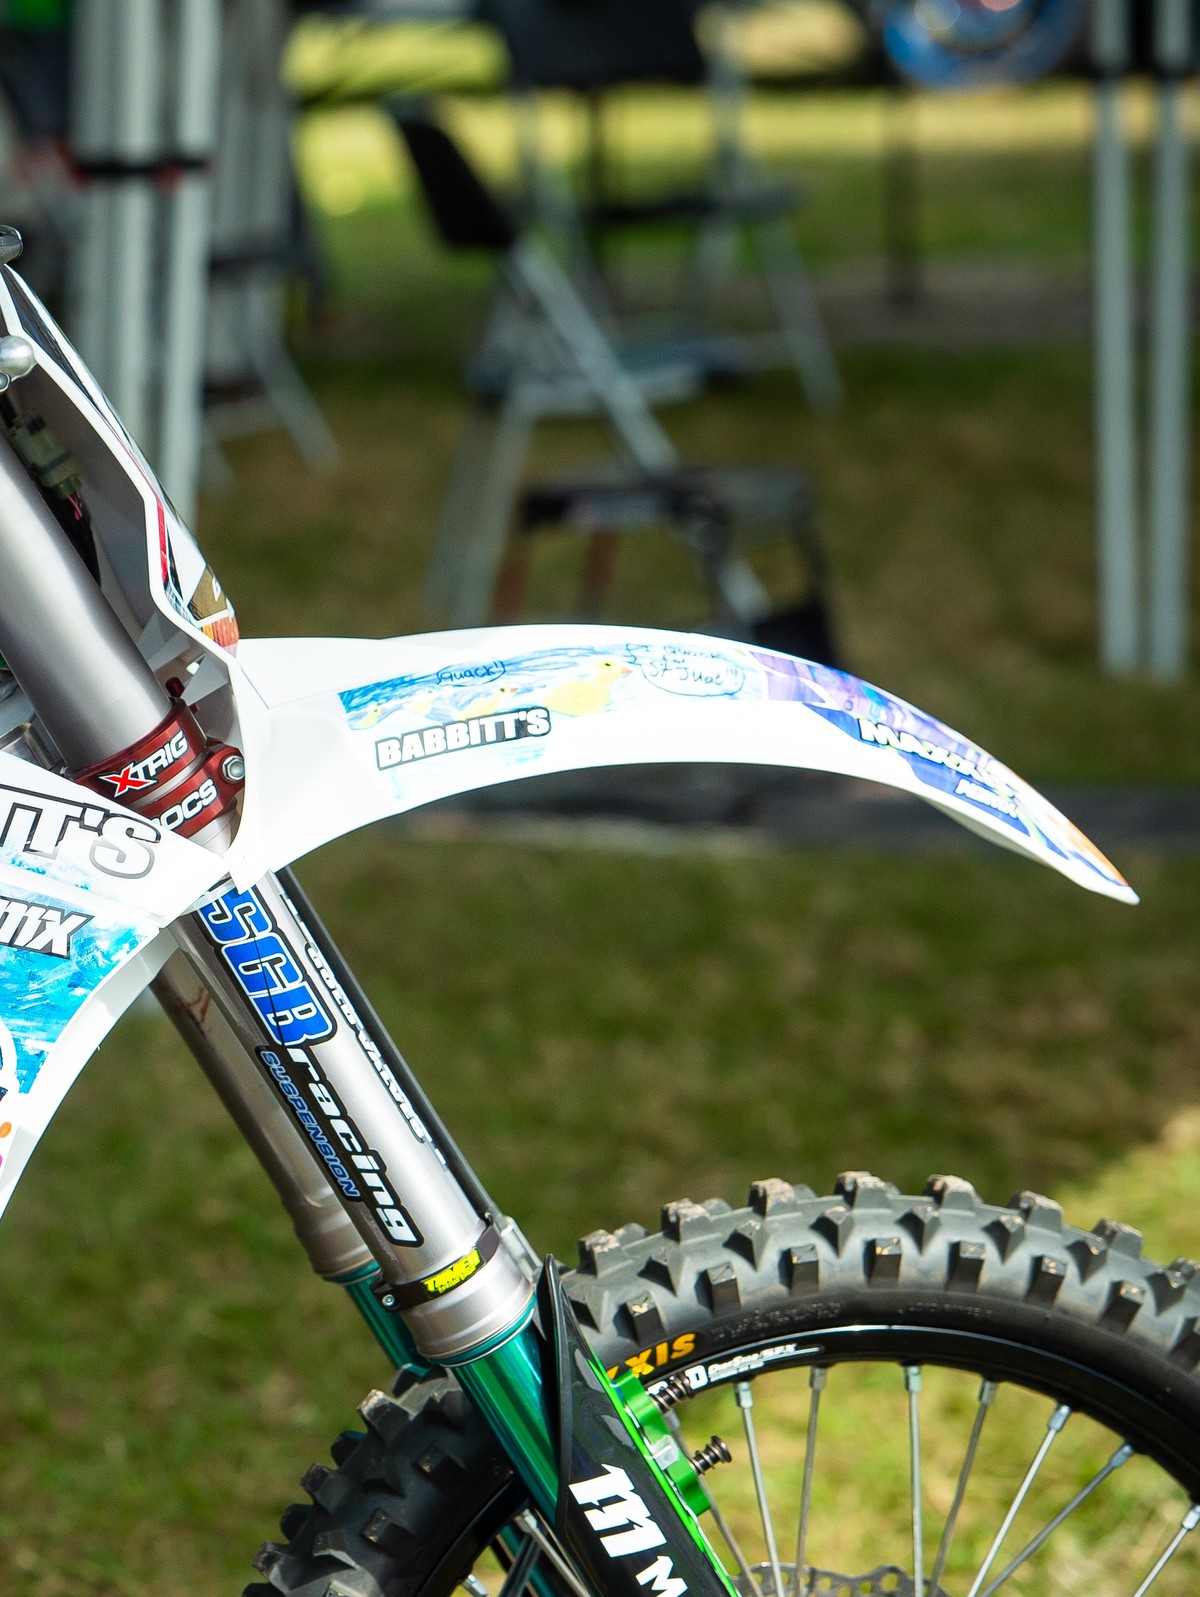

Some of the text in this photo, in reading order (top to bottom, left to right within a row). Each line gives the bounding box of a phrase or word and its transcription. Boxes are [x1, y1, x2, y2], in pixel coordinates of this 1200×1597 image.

[98, 729, 189, 798] XTRIG
[375, 706, 552, 771] BABBITT'S
[151, 777, 218, 831] OCS
[199, 886, 419, 1244] SGB racing
[260, 1050, 362, 1198] SUSPENSION
